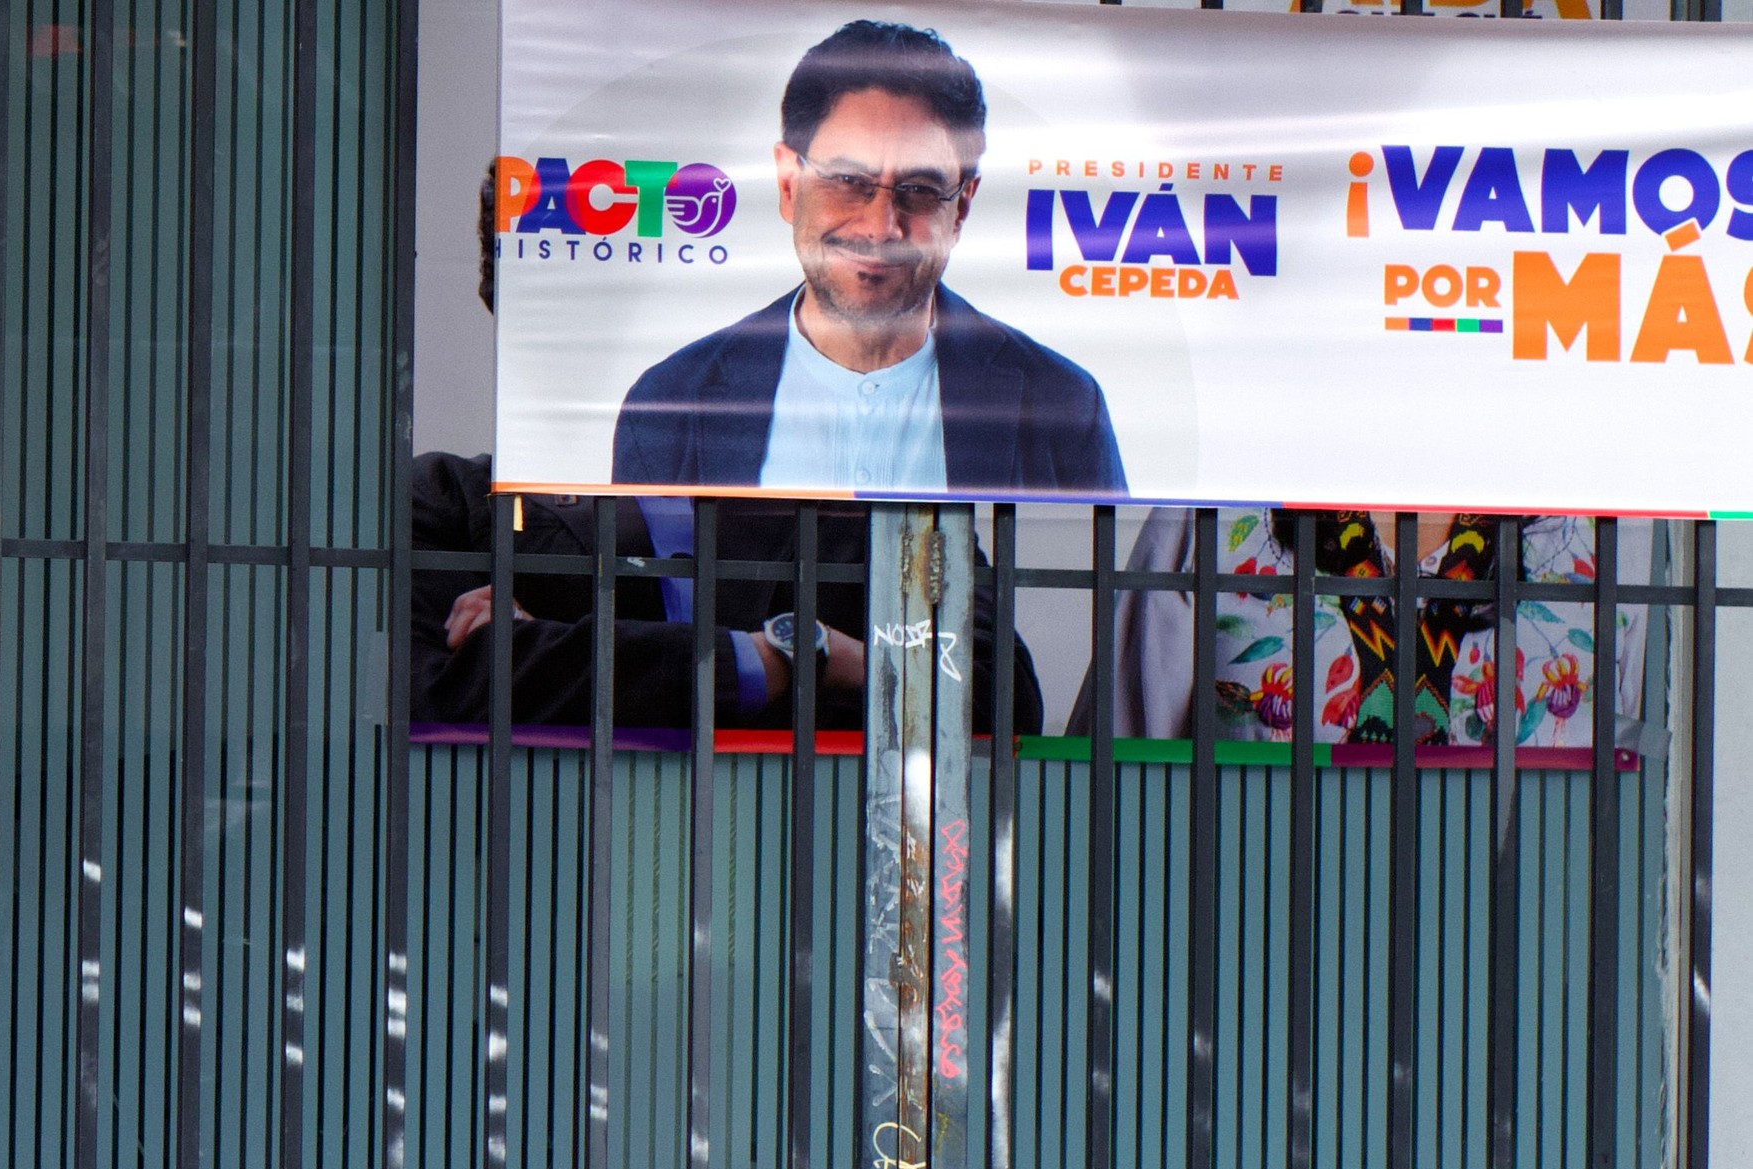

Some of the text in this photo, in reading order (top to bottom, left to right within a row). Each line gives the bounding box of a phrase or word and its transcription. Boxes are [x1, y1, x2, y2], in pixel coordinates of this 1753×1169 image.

[495, 156, 737, 238] PACTO
[1028, 158, 1284, 182] PRESIDENTE
[1026, 183, 1278, 276] IVÁN
[1059, 265, 1240, 300] CEPEDA
[1384, 217, 1753, 366] POR MÁ
